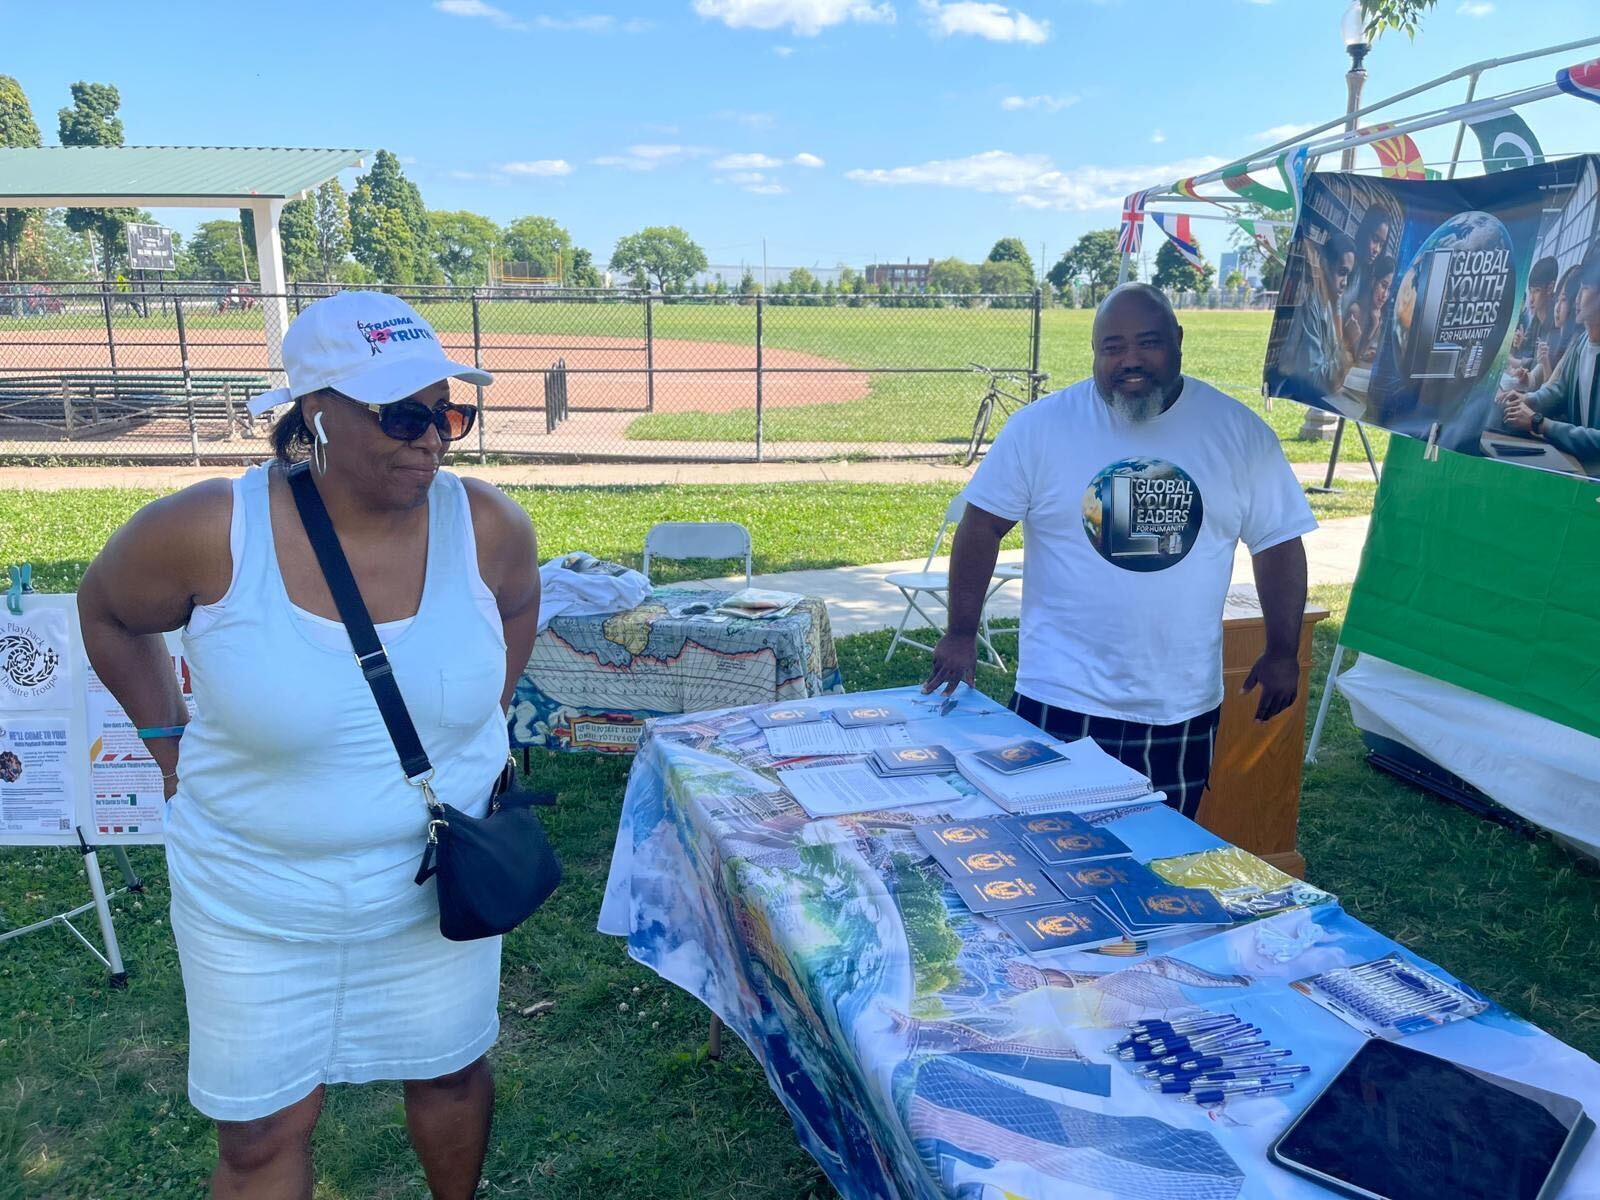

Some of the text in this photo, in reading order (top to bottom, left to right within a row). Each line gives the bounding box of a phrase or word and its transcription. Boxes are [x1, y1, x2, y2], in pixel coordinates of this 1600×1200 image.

[1453, 249, 1510, 275] GLOBAL
[1449, 274, 1508, 302] YOUTH
[367, 317, 414, 331] TRAUMA
[1440, 327, 1493, 341] FOR HUMANITY
[1135, 478, 1194, 494] GLOBAL
[1135, 493, 1193, 510] YOUTH
[7, 622, 45, 648] Playback
[31, 674, 59, 697] Troupe
